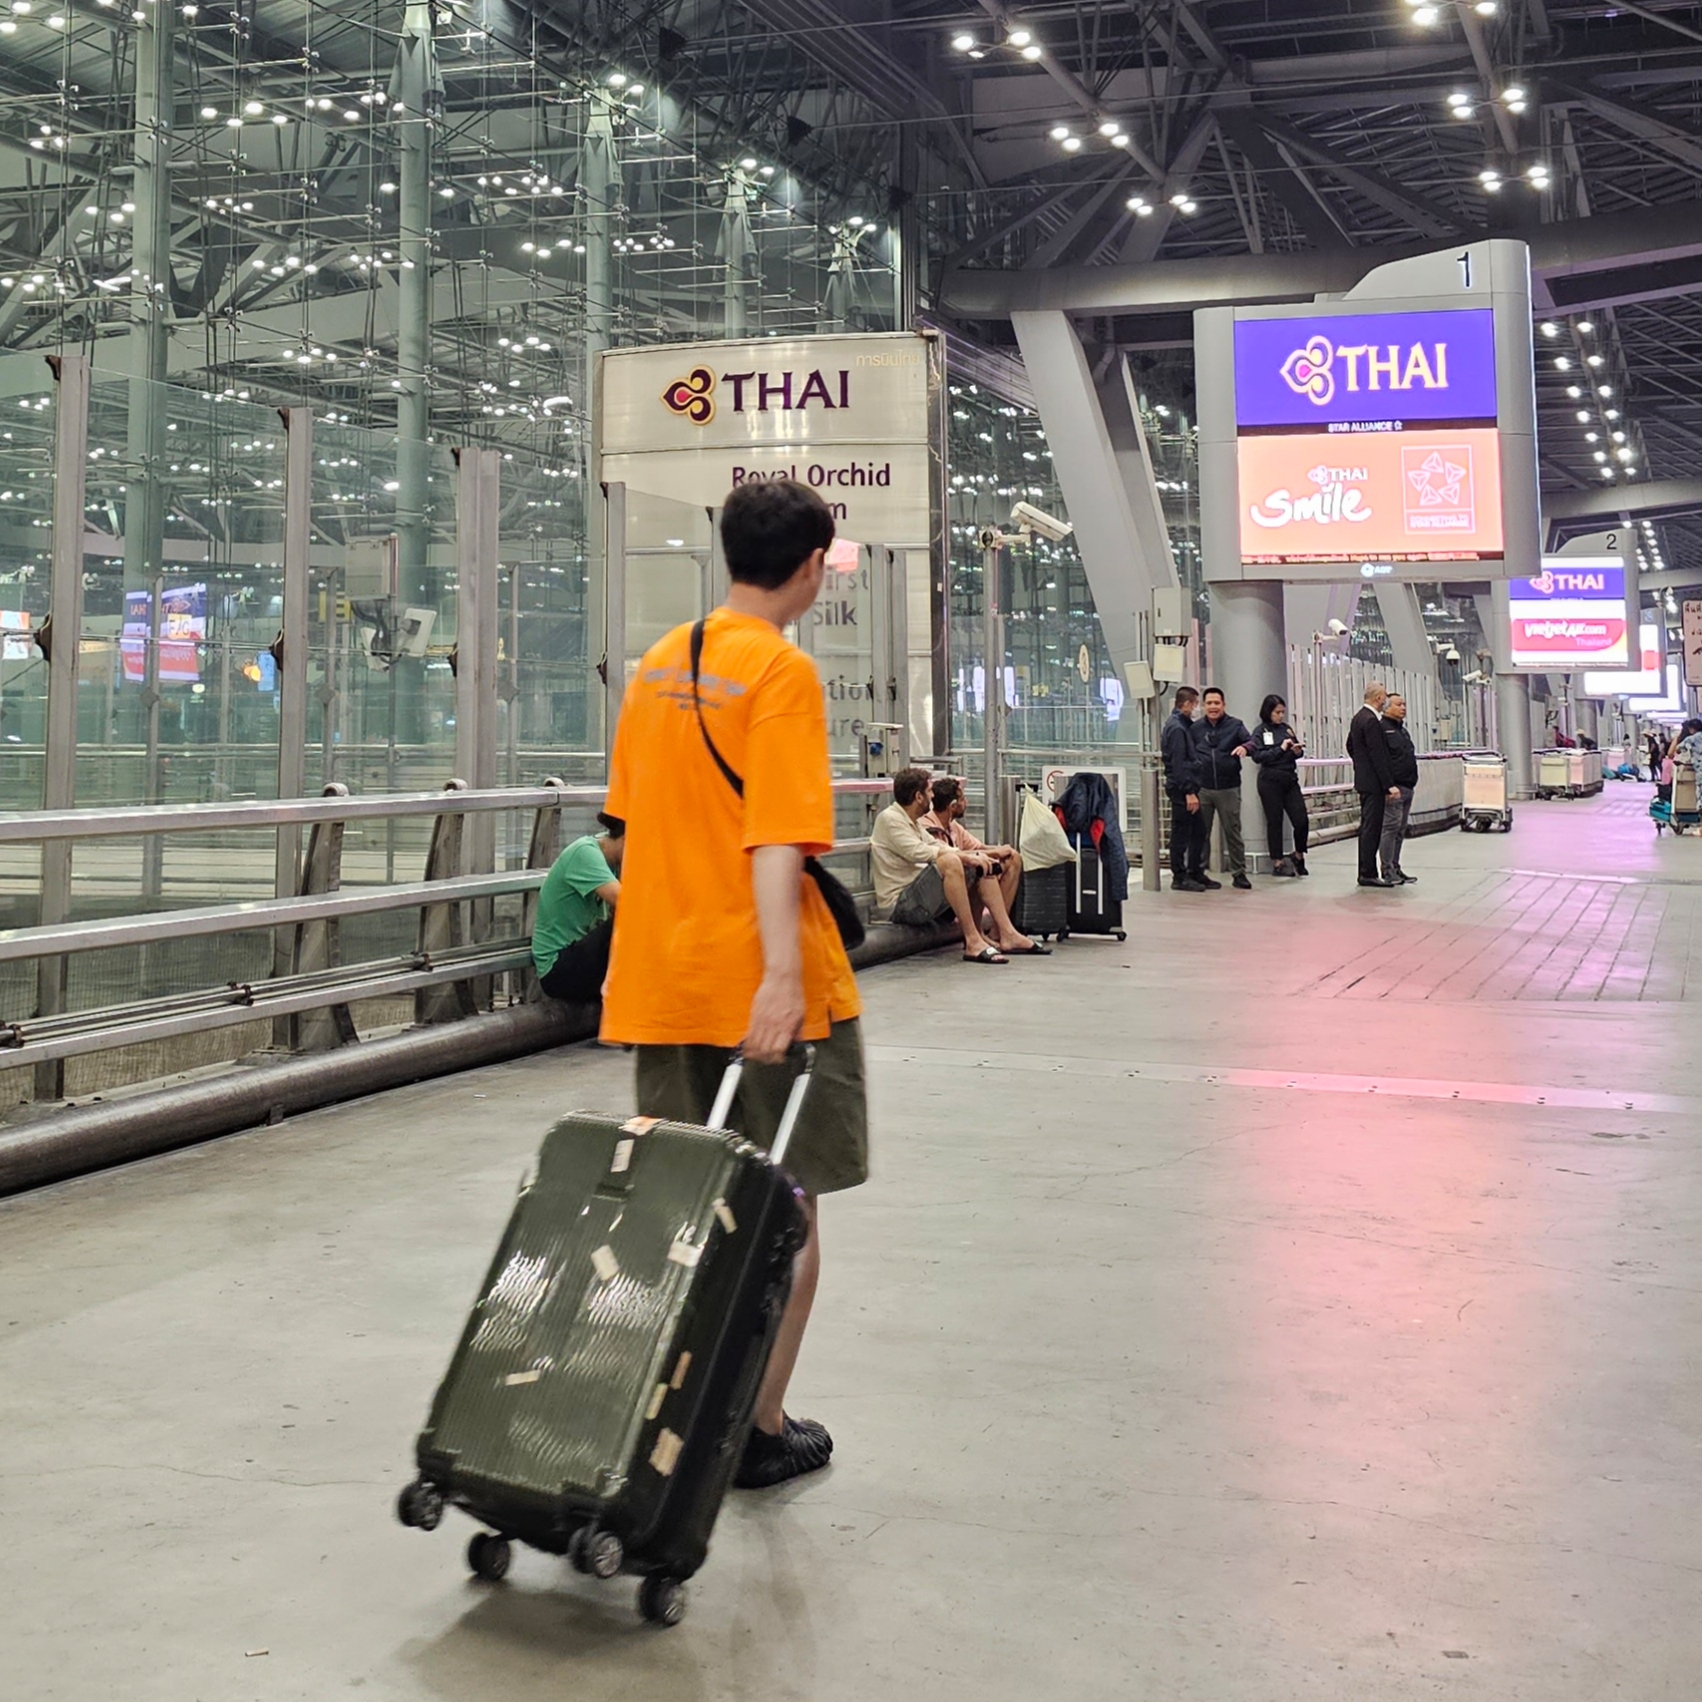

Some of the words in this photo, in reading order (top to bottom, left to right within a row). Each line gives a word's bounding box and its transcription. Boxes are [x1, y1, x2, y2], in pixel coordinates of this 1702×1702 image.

[1456, 251, 1470, 288] 1
[1336, 342, 1449, 392] THAI
[721, 369, 850, 412] THAI
[1328, 422, 1350, 433] STAR
[1351, 421, 1393, 432] ALLIANCE
[807, 462, 891, 487] Orchid
[1328, 467, 1369, 481] THAI
[1250, 482, 1373, 528] Smile
[1606, 534, 1618, 550] 2
[826, 565, 868, 590] irst
[1554, 574, 1604, 590] THAI
[813, 600, 857, 626] Silk
